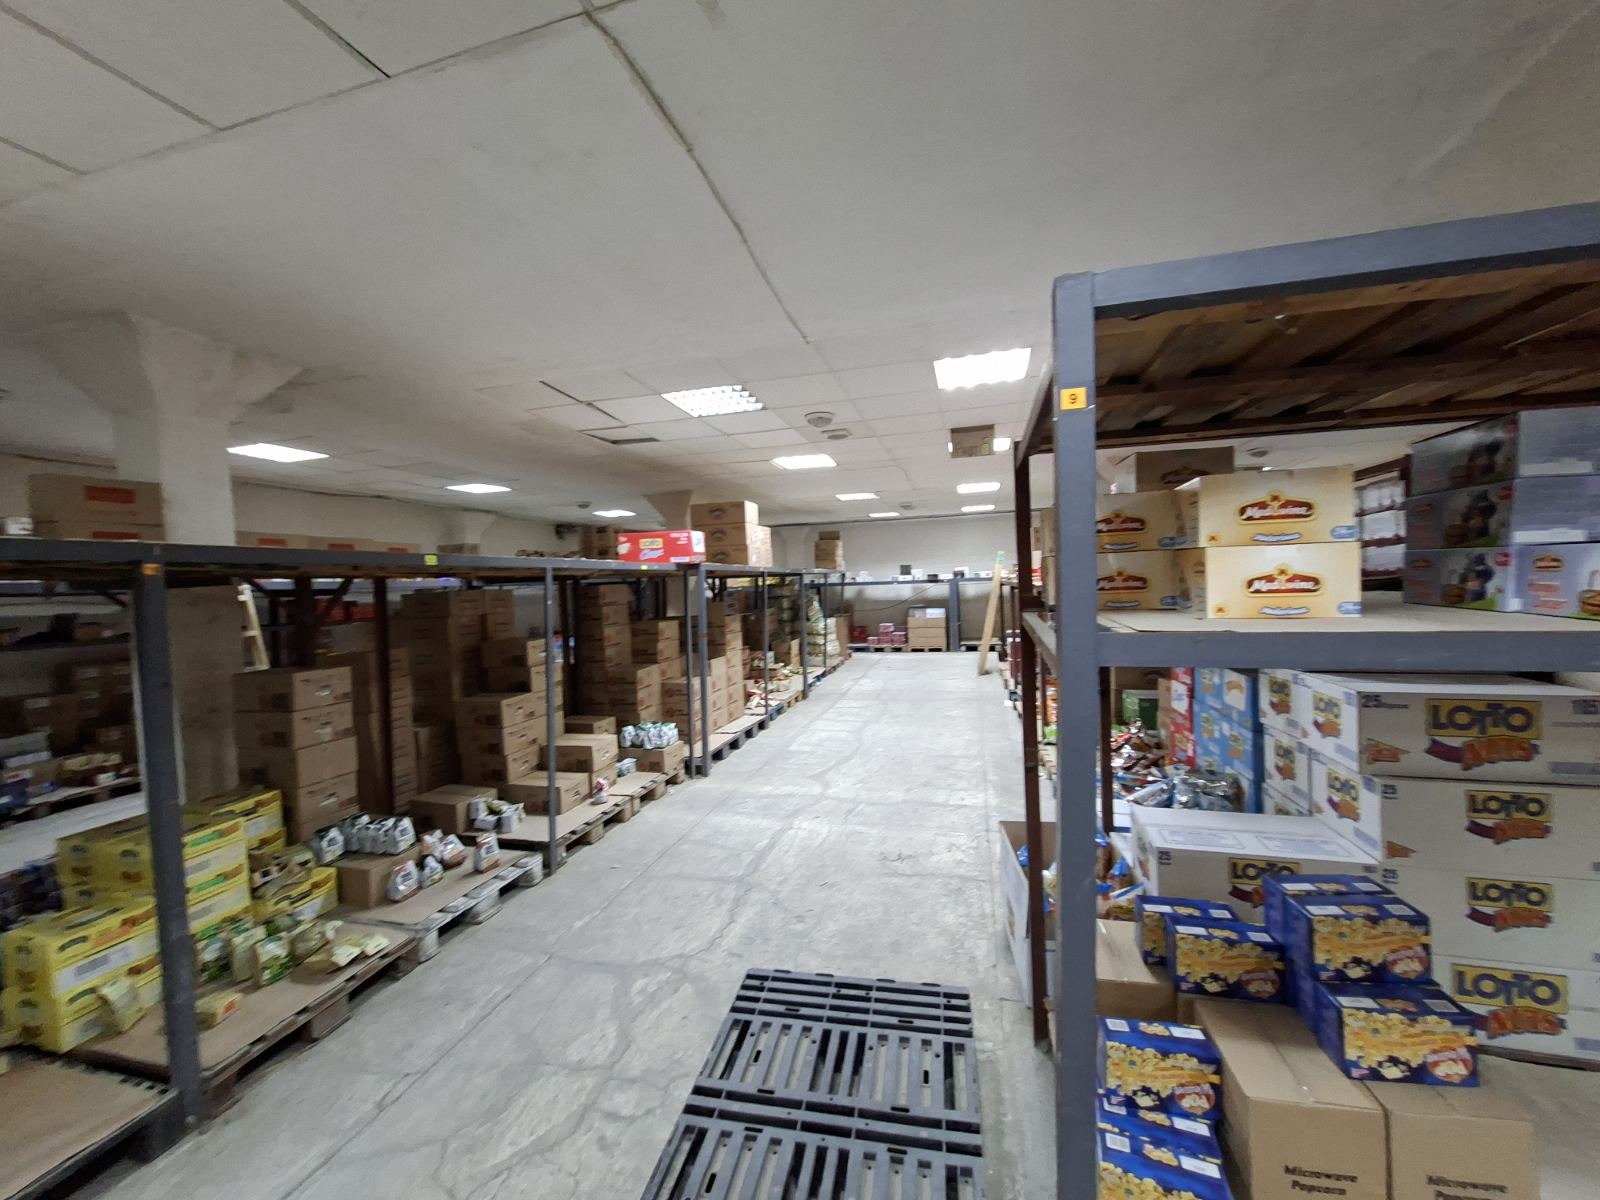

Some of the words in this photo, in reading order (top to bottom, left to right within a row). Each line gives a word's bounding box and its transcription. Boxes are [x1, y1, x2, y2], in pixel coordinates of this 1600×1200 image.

[1430, 702, 1534, 736] LOTTO
[1469, 793, 1546, 818] LOTTO
[1470, 881, 1547, 907] LOTTO
[1455, 969, 1562, 1006] LOTTO
